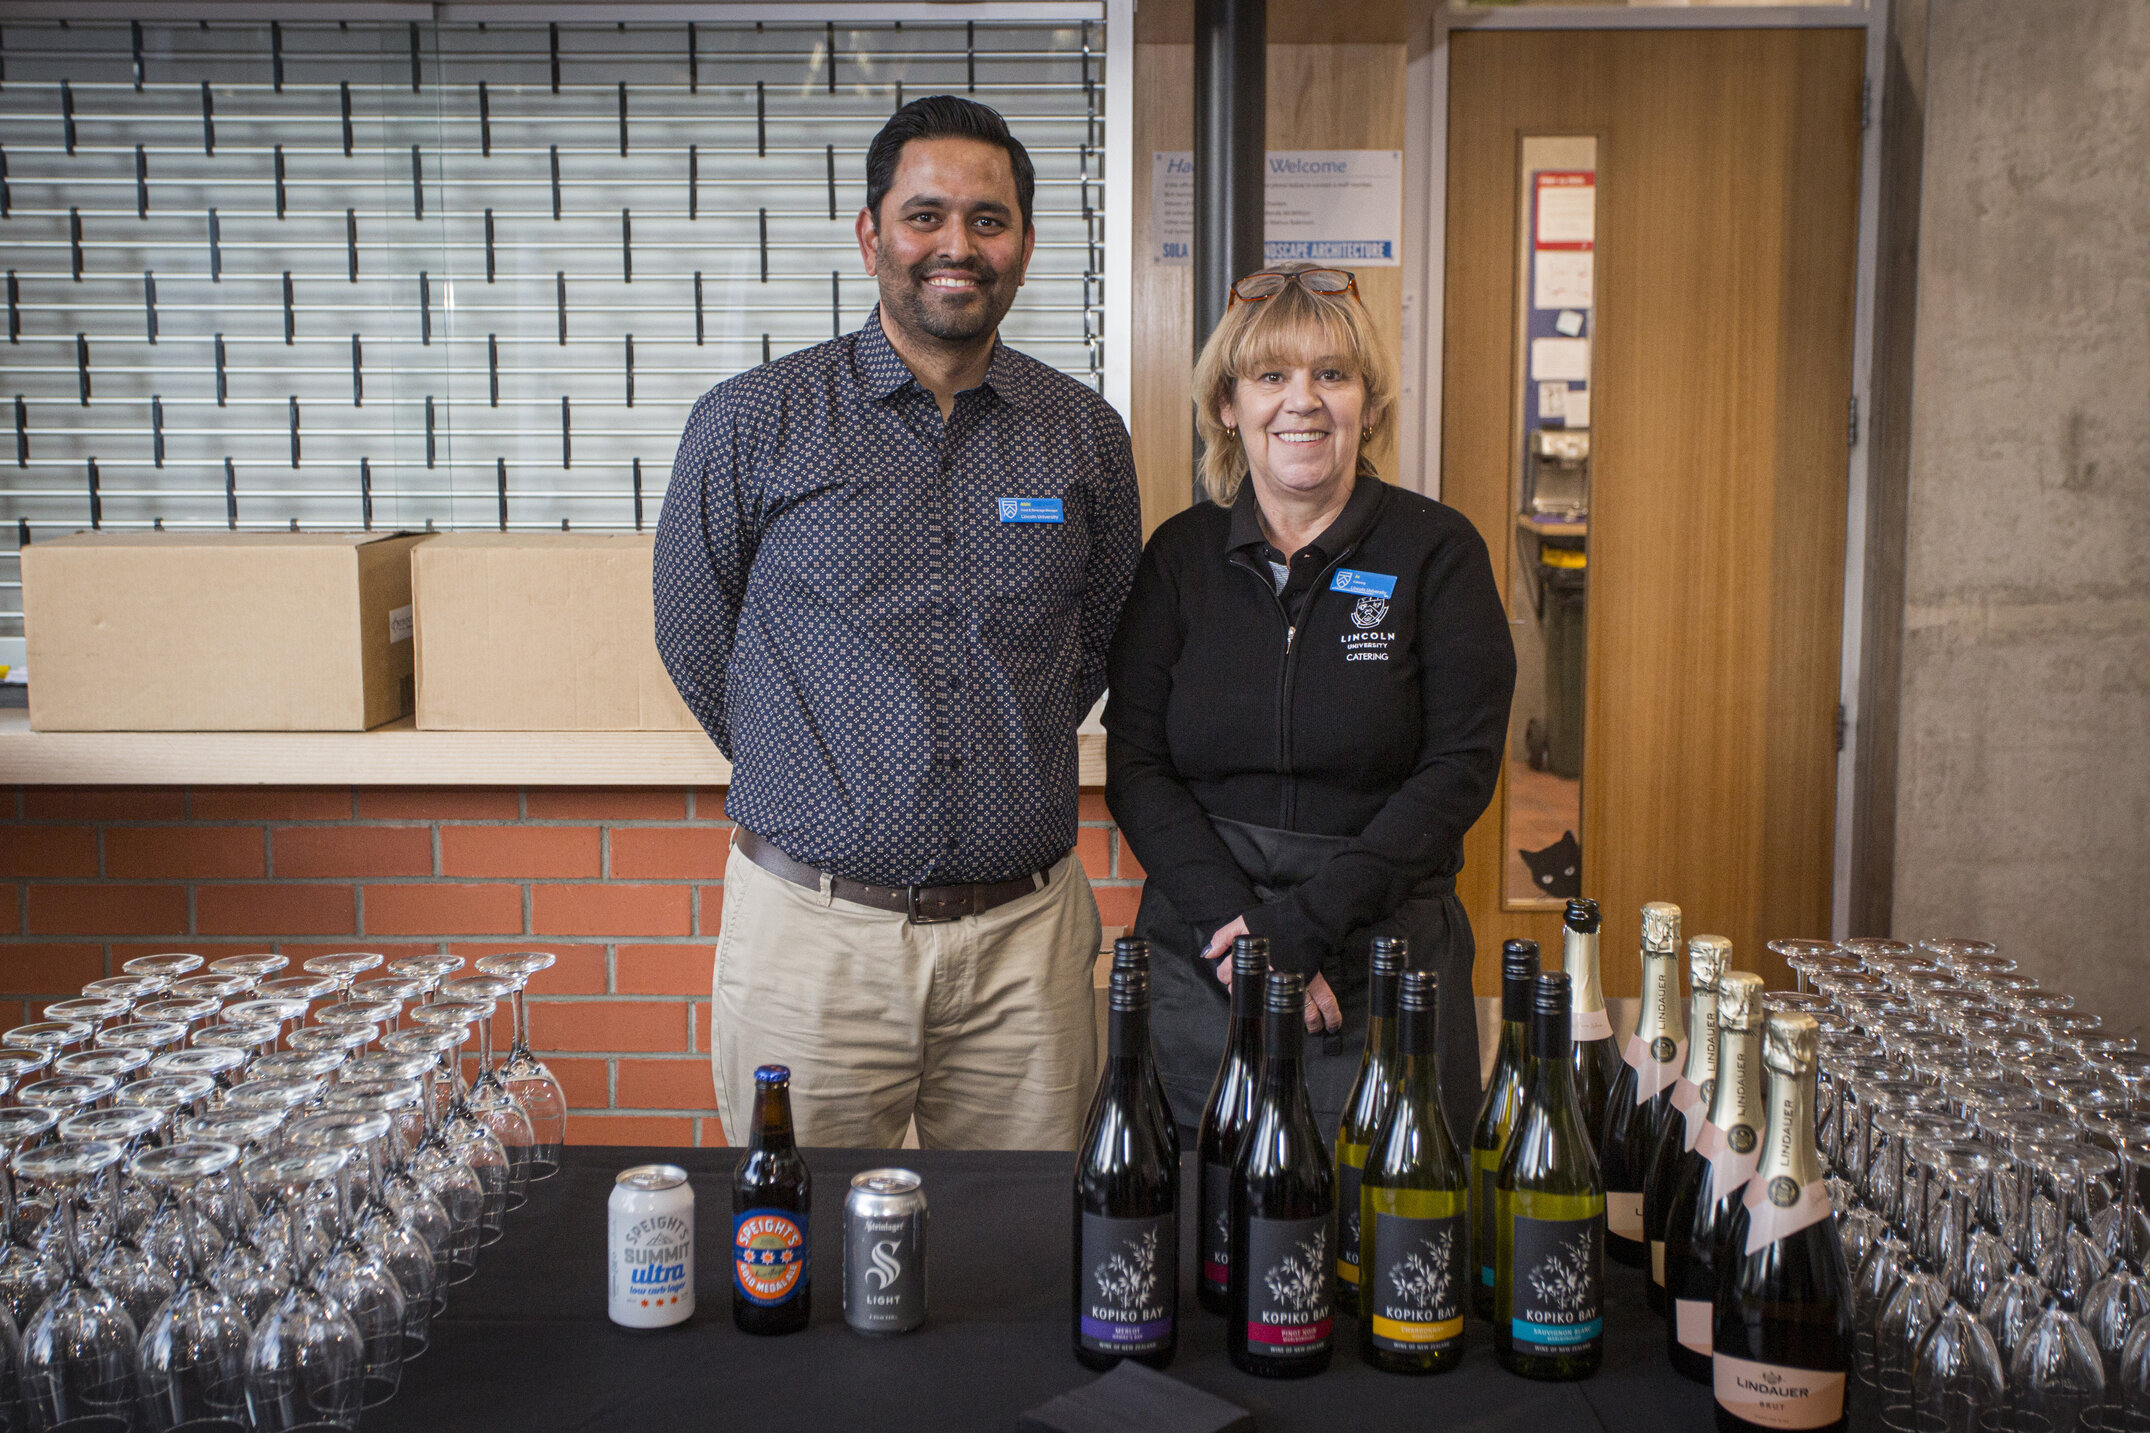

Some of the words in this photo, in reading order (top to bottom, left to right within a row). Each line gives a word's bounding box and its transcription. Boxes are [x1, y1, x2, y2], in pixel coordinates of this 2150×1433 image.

[1269, 158, 1348, 174] Welcome
[1264, 242, 1308, 258] NDSCAPE
[1311, 242, 1385, 258] ARCHITECTURE
[1340, 632, 1395, 643] LINCOLN
[1347, 642, 1388, 650] UNIVERSITY
[1346, 652, 1389, 661] CATERING
[1658, 974, 1666, 1030] LINDAUER
[1707, 1013, 1716, 1071] LINDAUER
[1737, 1053, 1746, 1117] LINDAUER
[1781, 1099, 1794, 1167] LINDAUER
[739, 1219, 799, 1247] SPEIGHT'S
[624, 1241, 690, 1265] SUMMIT
[632, 1263, 686, 1284] ultra
[740, 1263, 756, 1287] GOLD
[755, 1280, 788, 1293] MEDAL
[629, 1285, 646, 1295] low
[648, 1285, 666, 1295] carb
[866, 1295, 900, 1305] LIGHT
[1092, 1305, 1137, 1322] KOPIKO
[1143, 1306, 1163, 1321] BAY
[1262, 1311, 1309, 1325] KOPIKO
[1313, 1305, 1329, 1321] BAY
[1386, 1305, 1433, 1322] KOPIKO
[1438, 1306, 1456, 1321] BAY
[1526, 1308, 1573, 1324] KOPIKO
[1578, 1306, 1597, 1322] BAY
[1115, 1326, 1140, 1334] MERLOT
[1281, 1329, 1300, 1338] PINOT
[1533, 1327, 1572, 1336] SAUVIGNON
[1736, 1376, 1809, 1398] LINDAUER
[1759, 1401, 1785, 1411] BRUT
